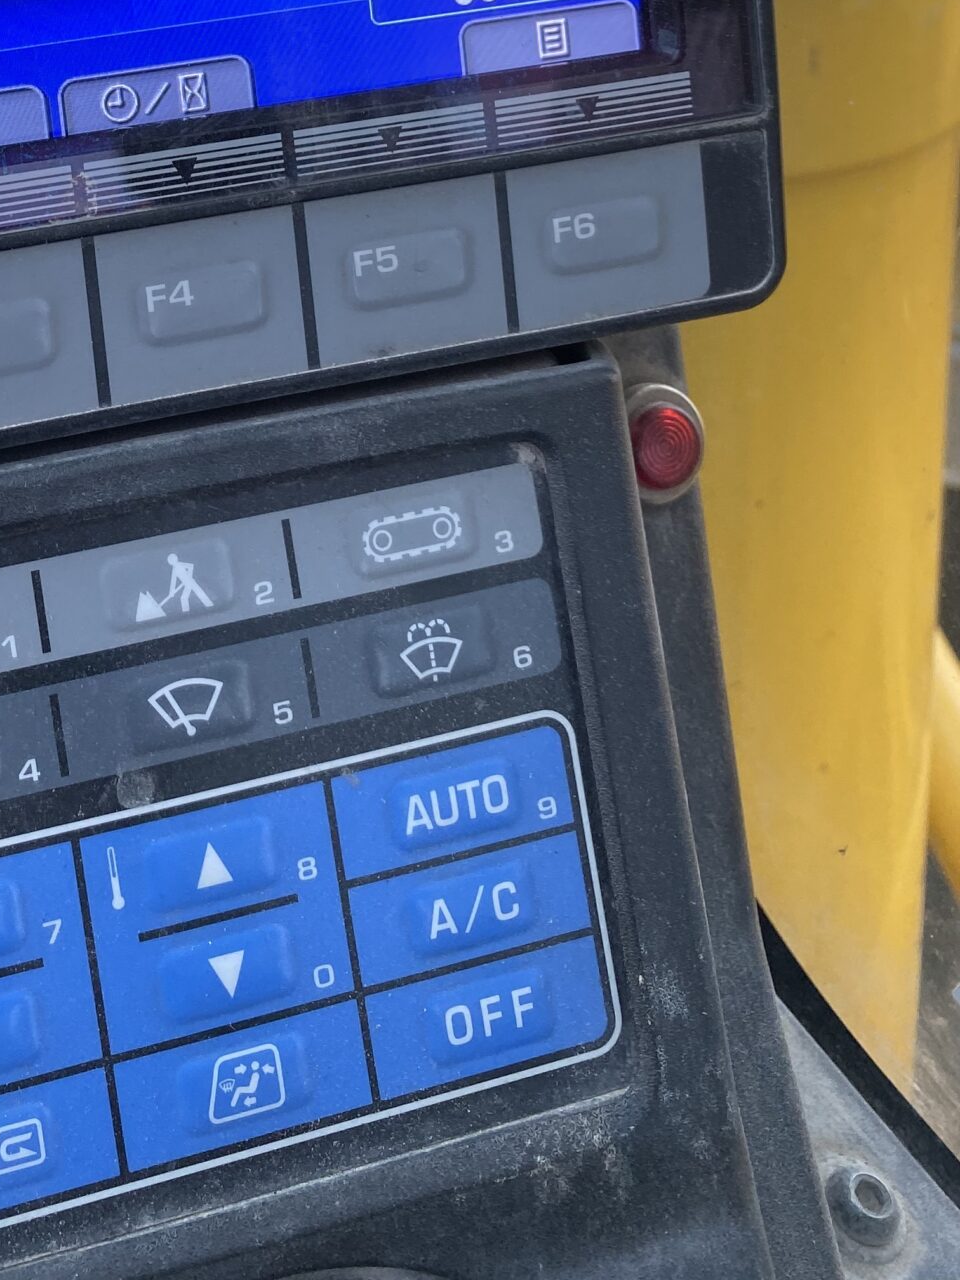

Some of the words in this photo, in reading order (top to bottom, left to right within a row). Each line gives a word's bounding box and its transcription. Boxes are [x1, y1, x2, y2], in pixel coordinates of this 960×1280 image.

[551, 211, 598, 245] F6
[352, 245, 401, 279] F5
[144, 278, 196, 314] F4
[494, 530, 514, 553] 3
[254, 581, 275, 606] 2
[0, 634, 18, 659] 1
[513, 645, 534, 669] 6
[273, 700, 294, 725] 5
[17, 759, 40, 783] 4
[404, 772, 510, 836] AUTO
[537, 795, 558, 820] 9
[297, 857, 318, 882] 8
[428, 880, 521, 940] A/C
[42, 918, 63, 946] 7
[444, 985, 536, 1047] OFF
